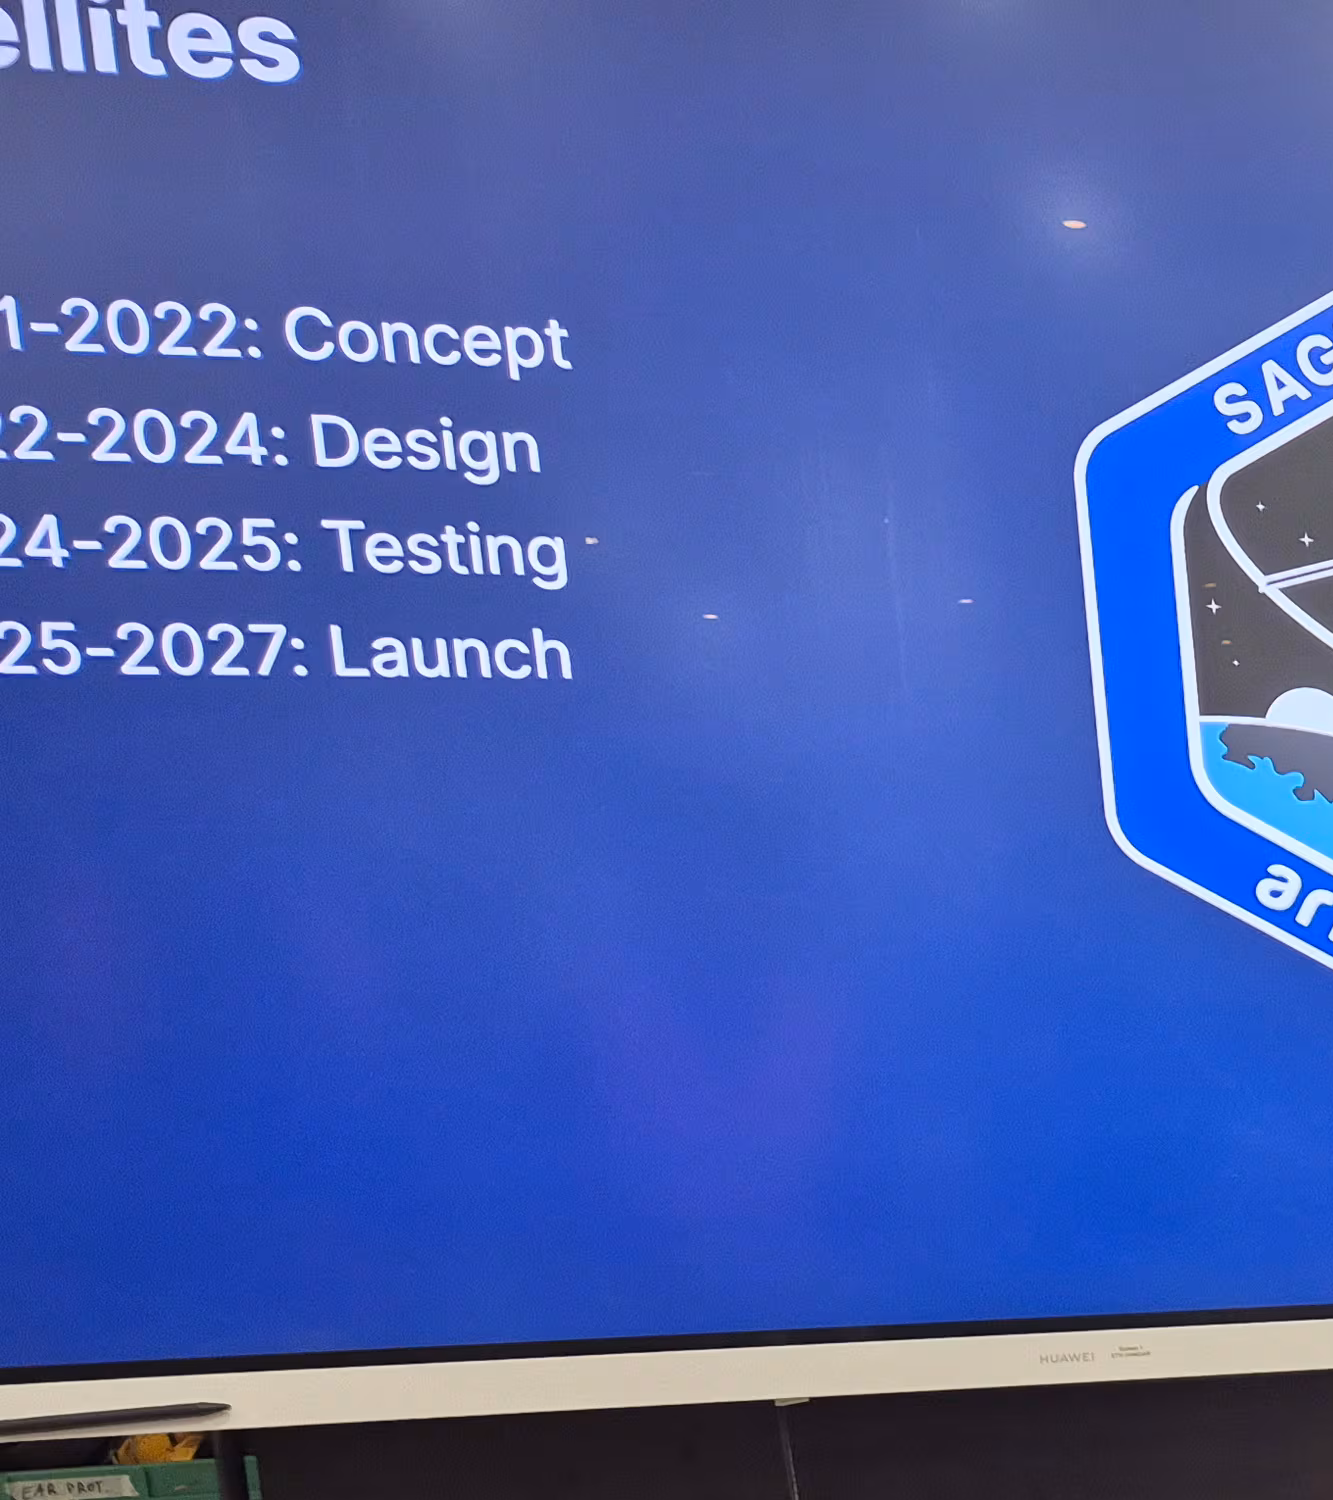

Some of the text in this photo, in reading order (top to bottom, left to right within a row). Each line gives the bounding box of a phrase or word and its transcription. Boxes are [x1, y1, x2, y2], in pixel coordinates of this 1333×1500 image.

[284, 305, 573, 381] Concept
[0, 404, 541, 485] 2-2024: Design
[320, 519, 568, 591] Testing
[329, 624, 573, 680] Launch
[1039, 1352, 1095, 1364] HUAWEI
[21, 1483, 57, 1500] EAR
